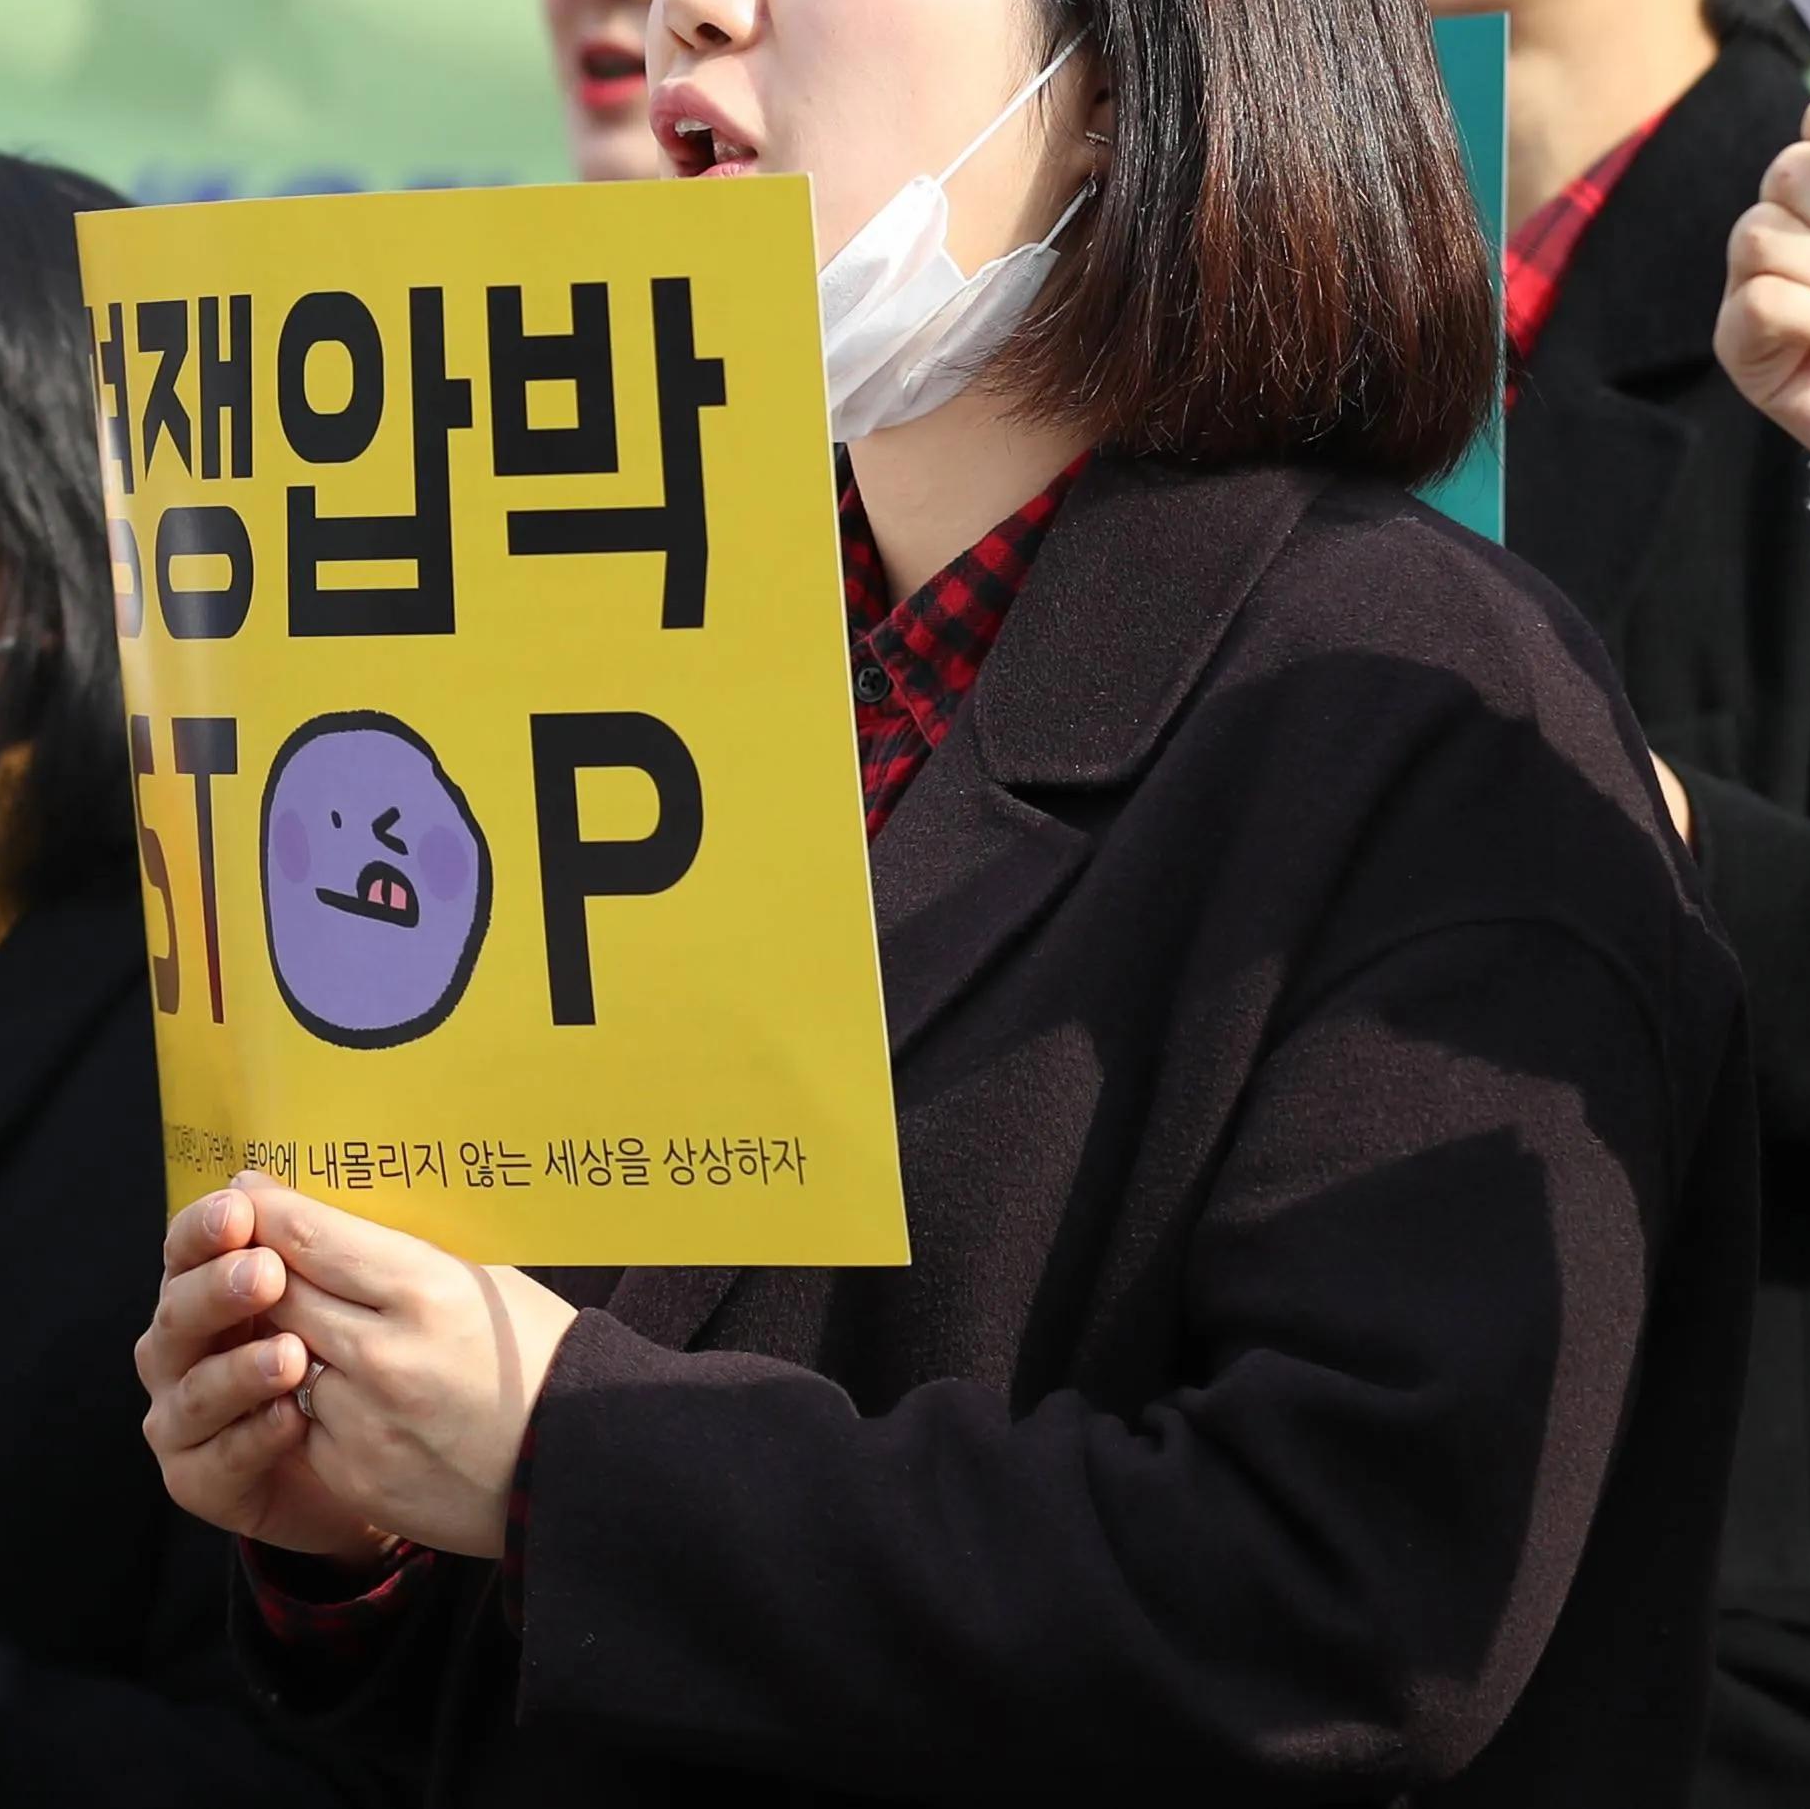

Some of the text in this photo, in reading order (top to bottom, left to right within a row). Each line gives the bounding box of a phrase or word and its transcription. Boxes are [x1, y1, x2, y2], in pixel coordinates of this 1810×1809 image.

[128, 707, 705, 1051] STOP
[308, 1140, 448, 1190] 내몰리지
[459, 1140, 531, 1188] 않는
[545, 1137, 650, 1186] 세상을
[663, 1136, 806, 1186] 상상하자
